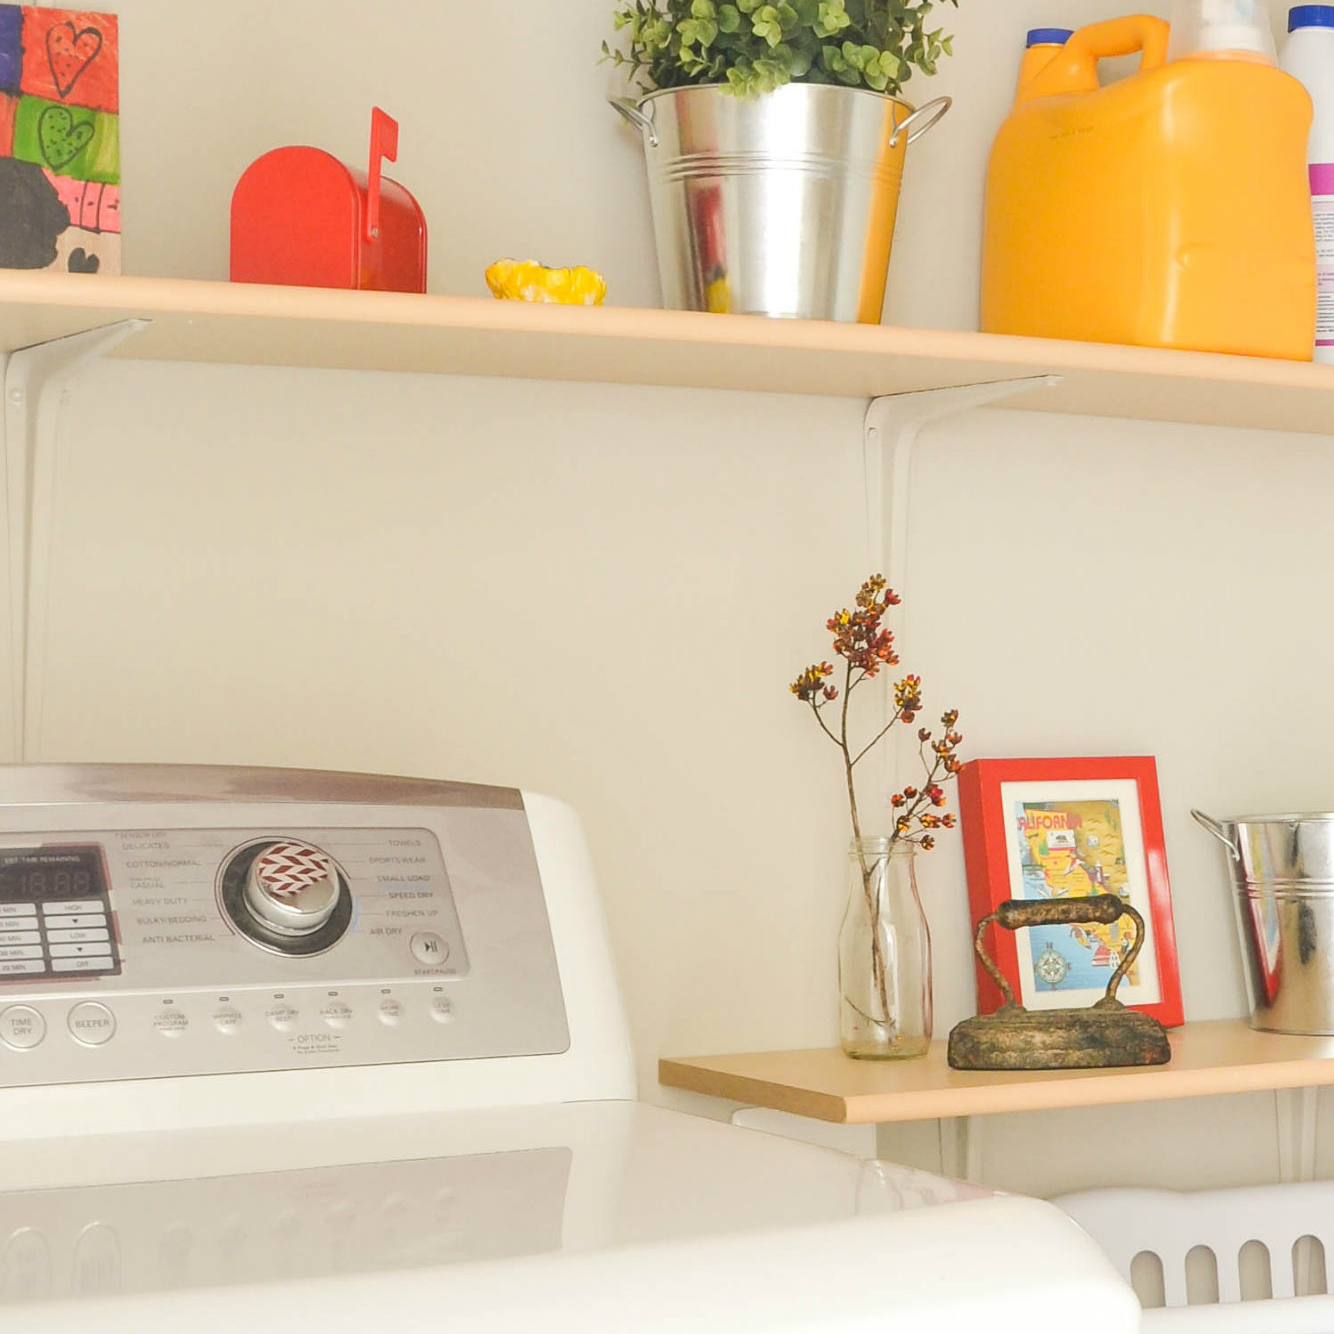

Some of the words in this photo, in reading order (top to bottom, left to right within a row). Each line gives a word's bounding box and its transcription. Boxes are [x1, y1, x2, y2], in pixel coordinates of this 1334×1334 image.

[388, 839, 422, 847] TOWELS
[166, 933, 215, 943] BACTERIAL
[10, 1018, 33, 1027] TIME
[75, 1018, 110, 1029] BEEPER
[153, 1020, 189, 1028] PROGRAM
[13, 1027, 32, 1036] DRY
[297, 1033, 332, 1044] OPTION
